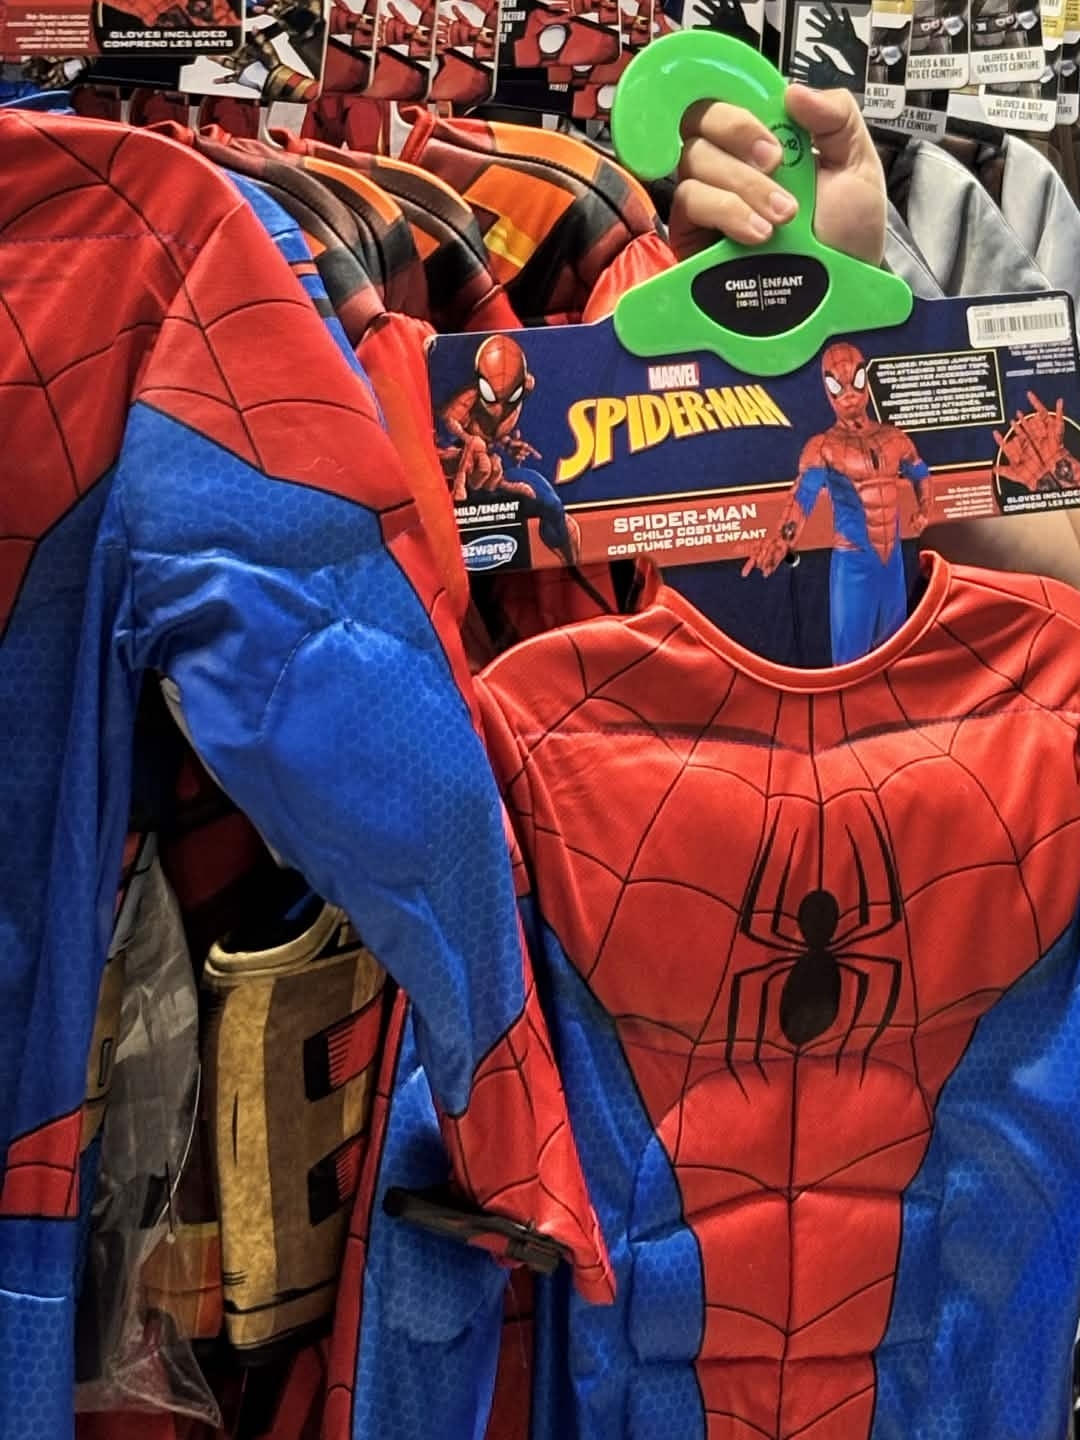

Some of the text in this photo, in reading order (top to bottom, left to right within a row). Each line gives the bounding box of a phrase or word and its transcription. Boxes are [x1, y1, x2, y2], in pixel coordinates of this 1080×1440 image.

[109, 30, 228, 39] GLOVES INCLUDED
[103, 39, 234, 48] COMPREND LES GANTS
[939, 56, 955, 67] BELT
[983, 53, 1009, 64] GLOVES
[1017, 50, 1032, 61] BELT
[931, 67, 963, 79] CEINTURE
[976, 64, 998, 74] GANTS
[1008, 60, 1040, 72] CEINTURE
[874, 86, 889, 98] BELT
[995, 97, 1044, 112] GLOVES BELT
[987, 107, 1008, 118] GANTS
[1018, 109, 1049, 122] CEINTURE
[725, 275, 804, 291] CHILD ENFANT
[736, 288, 792, 299] LARGE GRANDE
[648, 363, 700, 391] MARVEL
[1006, 494, 1042, 504] GLOVES
[454, 500, 520, 517] HILD/ENFANT
[1003, 502, 1047, 513] COMPREND
[1047, 500, 1063, 508] LES
[613, 503, 758, 533] SPIDER-MAN
[633, 520, 741, 542] CHILD COSTUME
[607, 528, 768, 556] COSTUME POUR ENFANT
[461, 542, 514, 558] azwares
